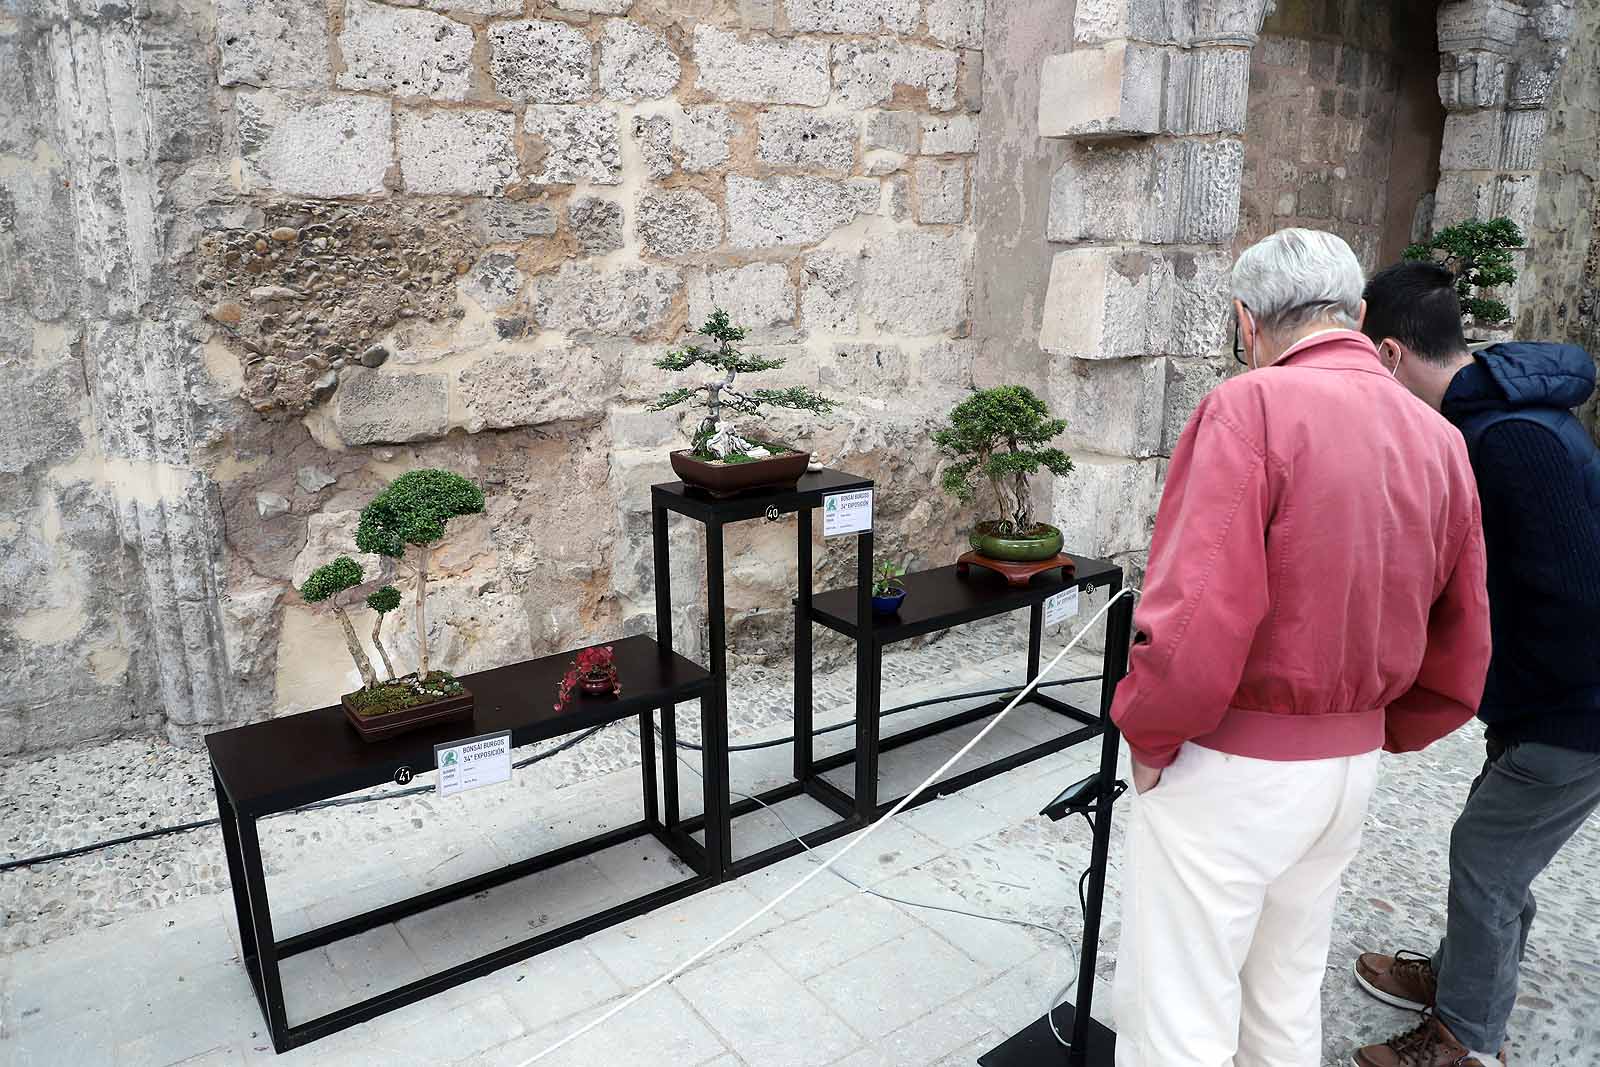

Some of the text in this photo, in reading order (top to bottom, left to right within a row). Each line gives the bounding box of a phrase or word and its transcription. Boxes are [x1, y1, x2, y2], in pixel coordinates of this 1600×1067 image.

[768, 508, 778, 519] 40
[483, 739, 505, 749] BURGOS
[399, 770, 410, 781] 41
